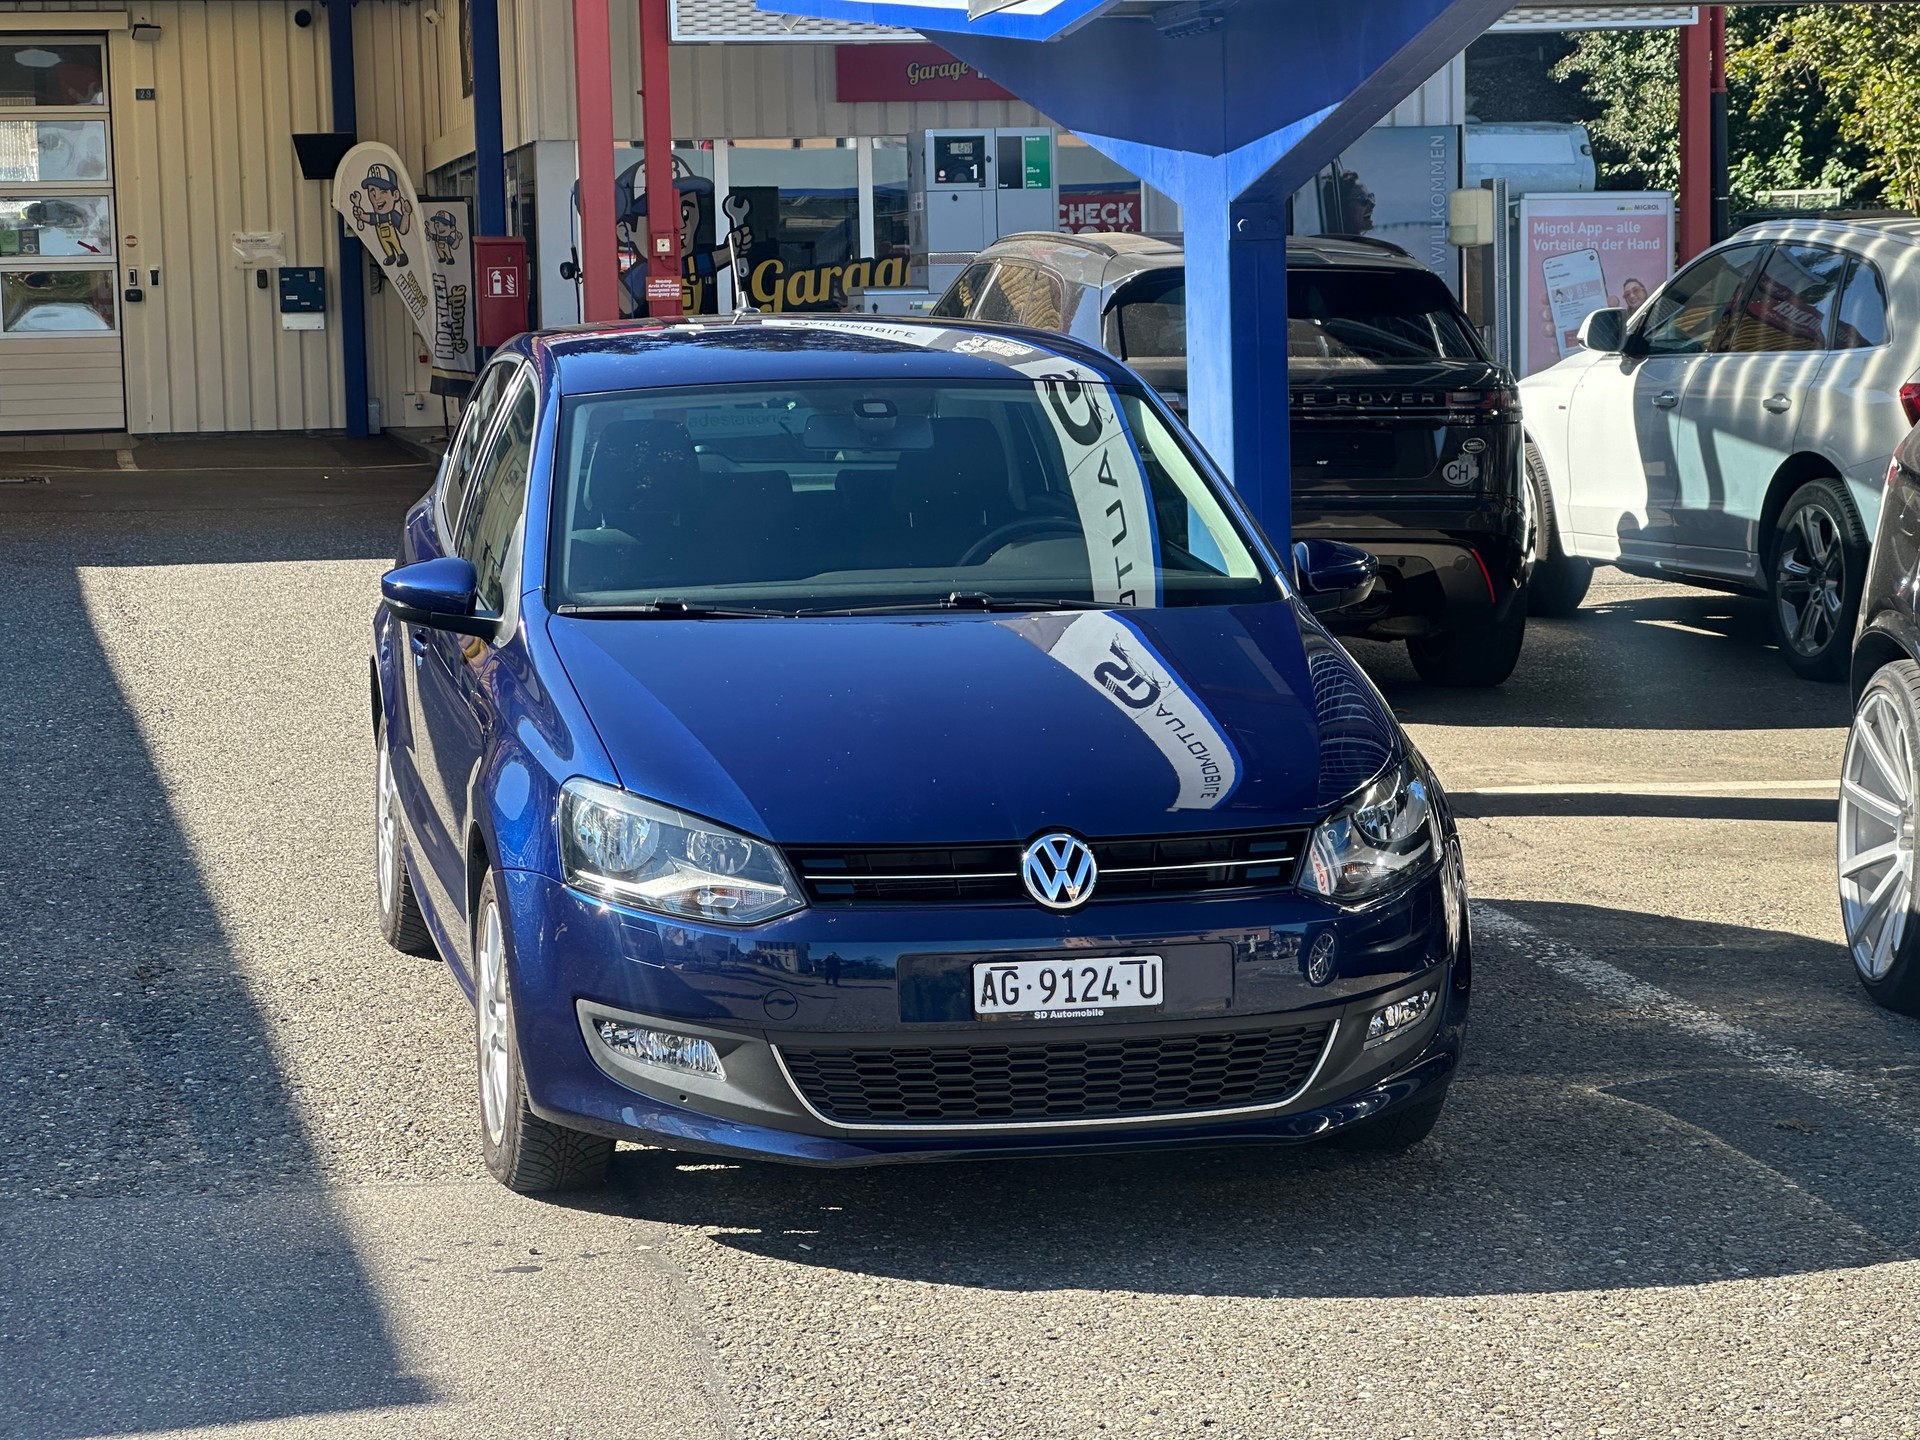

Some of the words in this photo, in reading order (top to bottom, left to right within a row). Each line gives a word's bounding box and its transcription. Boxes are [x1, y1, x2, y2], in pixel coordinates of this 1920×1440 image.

[907, 61, 969, 86] Garage
[139, 90, 152, 99] 29
[970, 164, 978, 179] 1
[1430, 135, 1447, 265] WILLKOMMEN
[1533, 221, 1575, 237] Migrol
[1577, 222, 1603, 237] App
[1616, 220, 1641, 233] alle
[1533, 238, 1584, 251] Vorteile
[1587, 239, 1599, 250] in
[1602, 239, 1624, 250] der
[1627, 237, 1660, 250] Hand
[751, 257, 912, 313] Garag
[1336, 392, 1436, 405] ROVER
[1447, 464, 1469, 481] CH
[1024, 835, 1096, 908] VW
[1034, 1011, 1048, 1020] SD
[1050, 1008, 1105, 1019] Automobile
